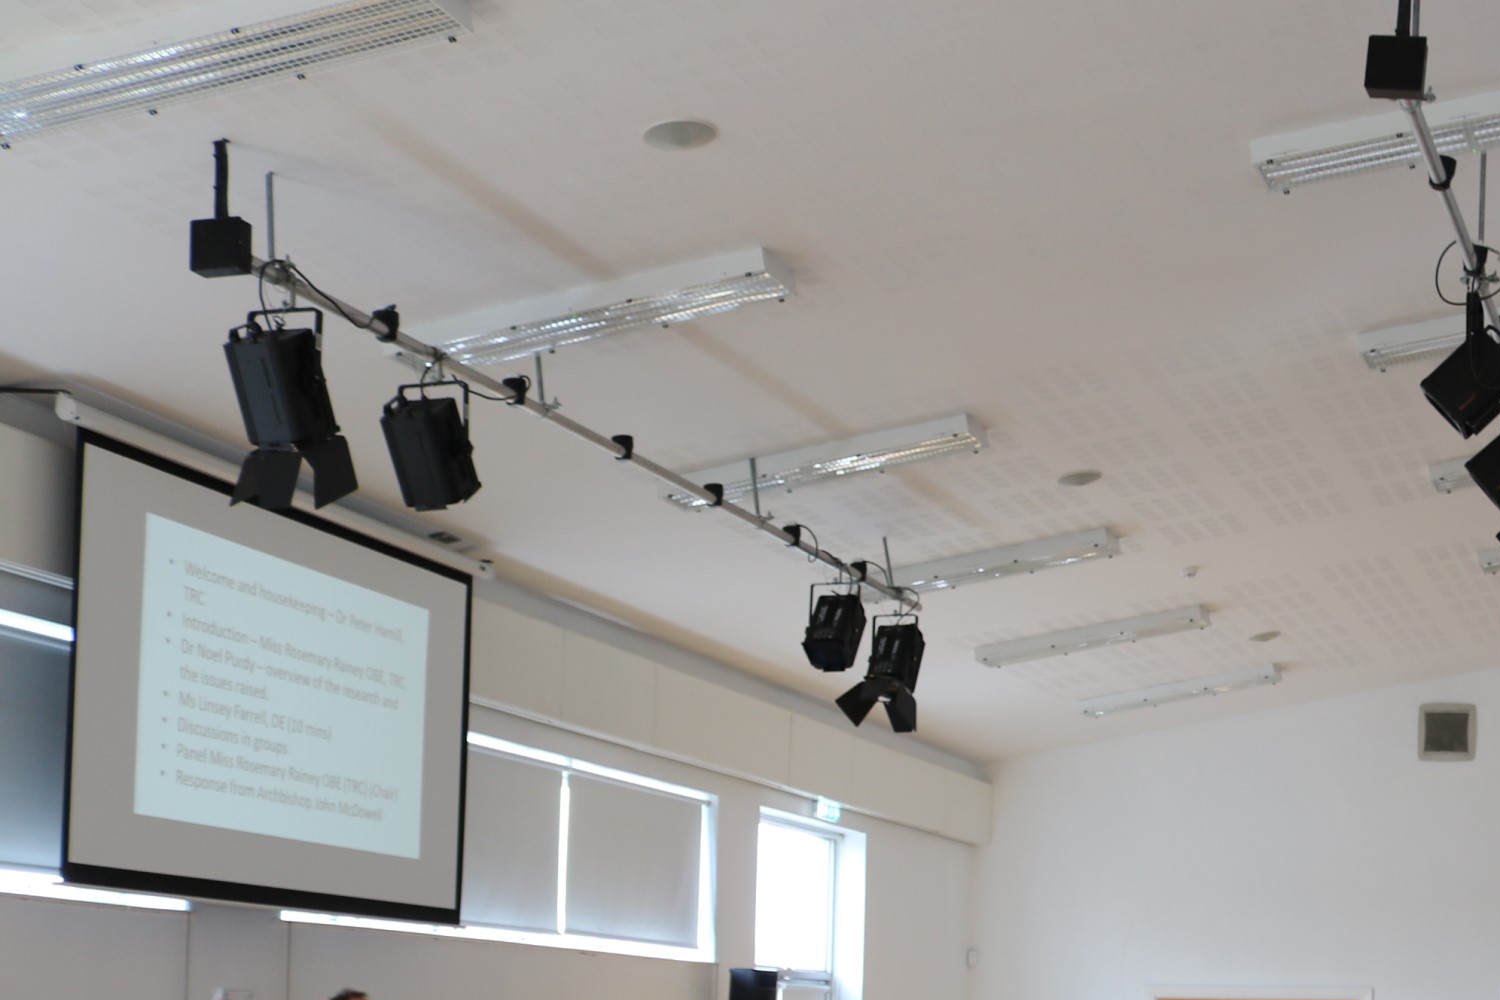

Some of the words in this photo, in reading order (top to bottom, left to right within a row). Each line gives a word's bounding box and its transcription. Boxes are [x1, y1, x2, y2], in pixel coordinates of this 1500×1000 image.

[183, 585, 206, 606] TRC
[184, 560, 235, 589] Welcome
[237, 580, 257, 596] and
[259, 583, 326, 622] housekeeping
[349, 614, 372, 633] Peter
[182, 613, 248, 644] Introduction
[259, 635, 282, 655] Miss
[285, 643, 332, 671] Rosemary
[179, 666, 198, 683] the
[201, 672, 232, 691] issues
[181, 638, 194, 655] Dr
[197, 643, 222, 663] Noel
[225, 650, 255, 674] Purdy
[265, 666, 309, 686] overview
[312, 676, 325, 690] of
[325, 680, 340, 695] the
[342, 686, 379, 706] research
[178, 691, 195, 708] Ms
[198, 695, 231, 720] Linsey
[177, 716, 238, 745] Discussions
[241, 732, 251, 747] in
[253, 737, 288, 756] groups
[176, 743, 206, 763] Panel
[210, 750, 234, 769] Miss
[236, 755, 286, 781] Rosemary
[176, 769, 228, 793] Response
[230, 779, 255, 798] from
[257, 785, 312, 810] Archbishop
[314, 796, 336, 813] John
